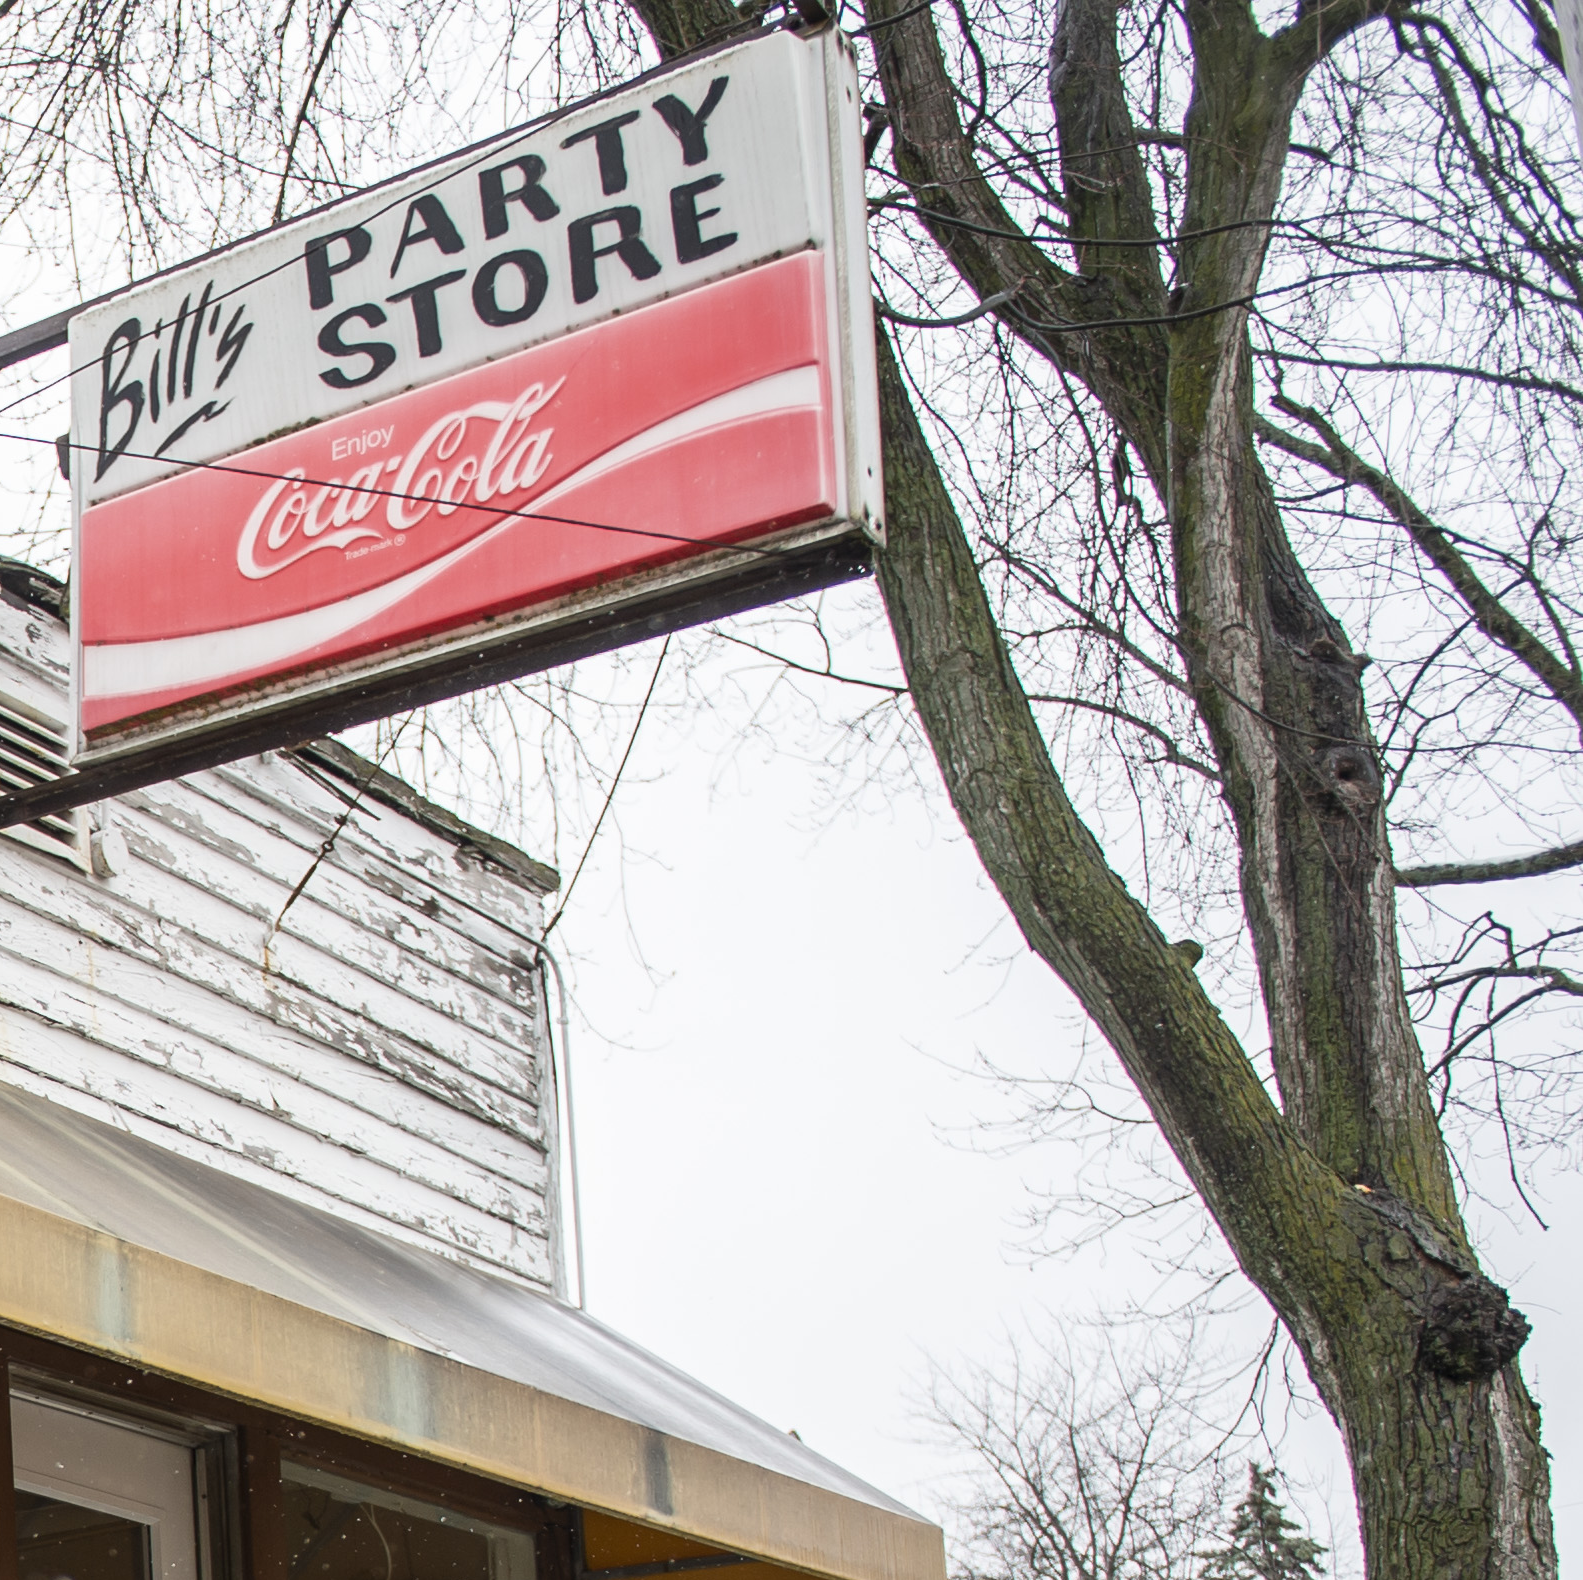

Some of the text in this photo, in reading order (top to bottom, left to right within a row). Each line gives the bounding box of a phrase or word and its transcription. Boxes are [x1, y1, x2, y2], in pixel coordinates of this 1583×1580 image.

[305, 76, 730, 311] PARTY
[317, 174, 739, 390] STORE
[94, 280, 255, 483] Bill's
[237, 375, 567, 579] Coca-Cola
[331, 424, 395, 461] Enjoy
